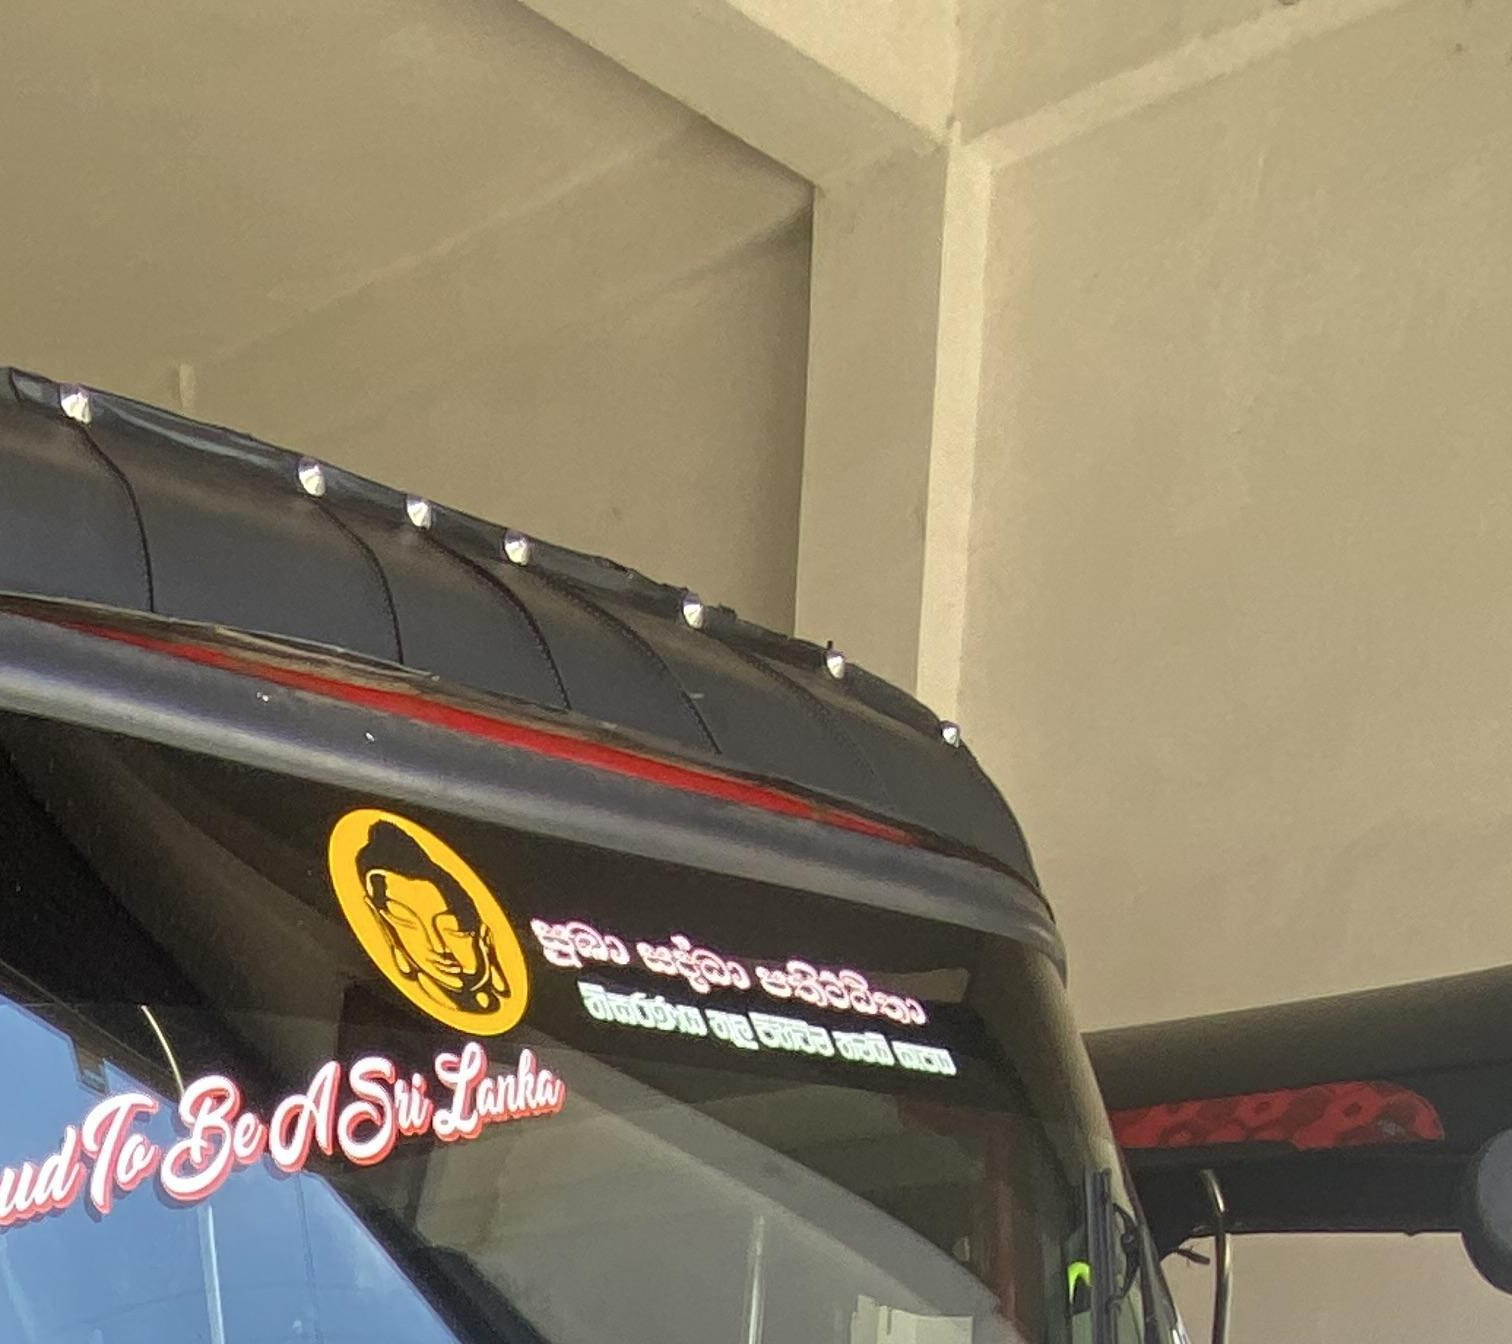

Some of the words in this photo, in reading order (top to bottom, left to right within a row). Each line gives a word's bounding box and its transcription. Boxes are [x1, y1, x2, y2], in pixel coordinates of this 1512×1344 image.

[82, 1093, 160, 1213] To
[159, 1075, 268, 1204] Be
[269, 1061, 341, 1171] A
[338, 1056, 430, 1166] Sri
[432, 1042, 565, 1142] Lanka
